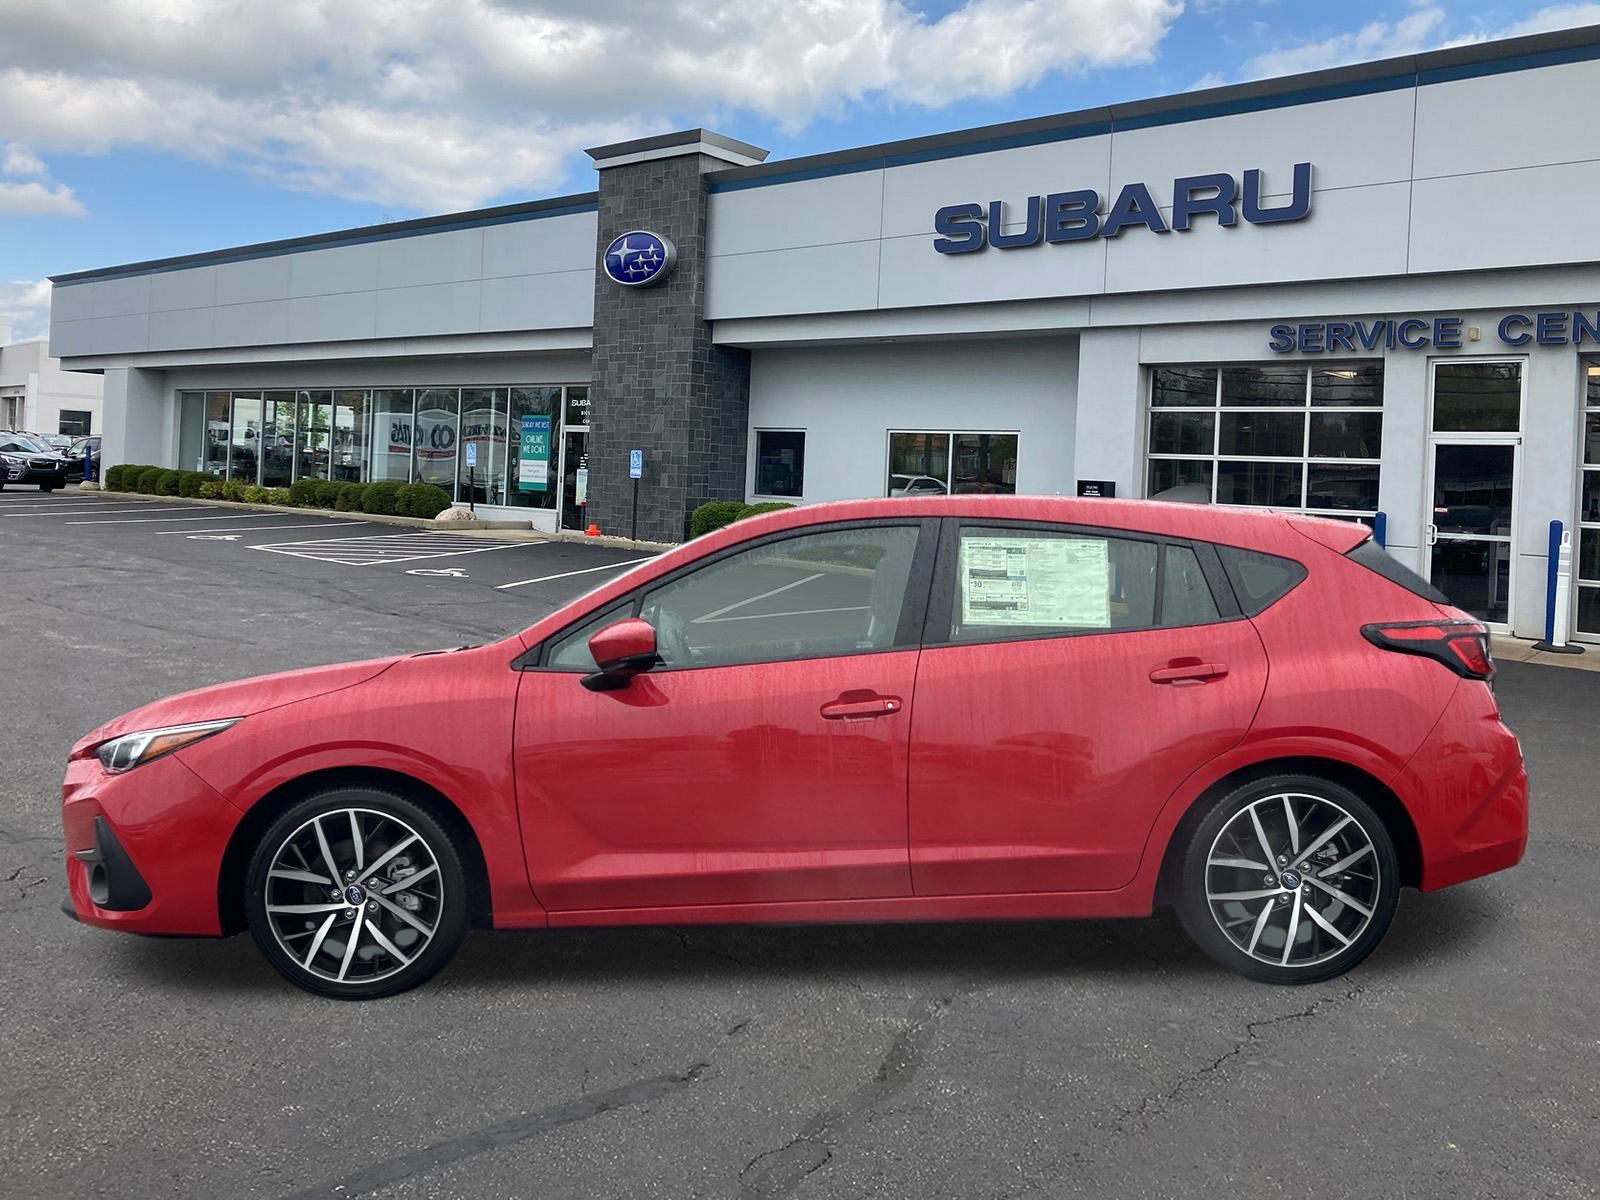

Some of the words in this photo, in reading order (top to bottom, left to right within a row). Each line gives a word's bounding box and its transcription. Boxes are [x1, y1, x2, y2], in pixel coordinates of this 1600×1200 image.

[934, 162, 1313, 255] SUBARU
[1268, 317, 1464, 353] SERVICE
[1497, 311, 1600, 346] CEN
